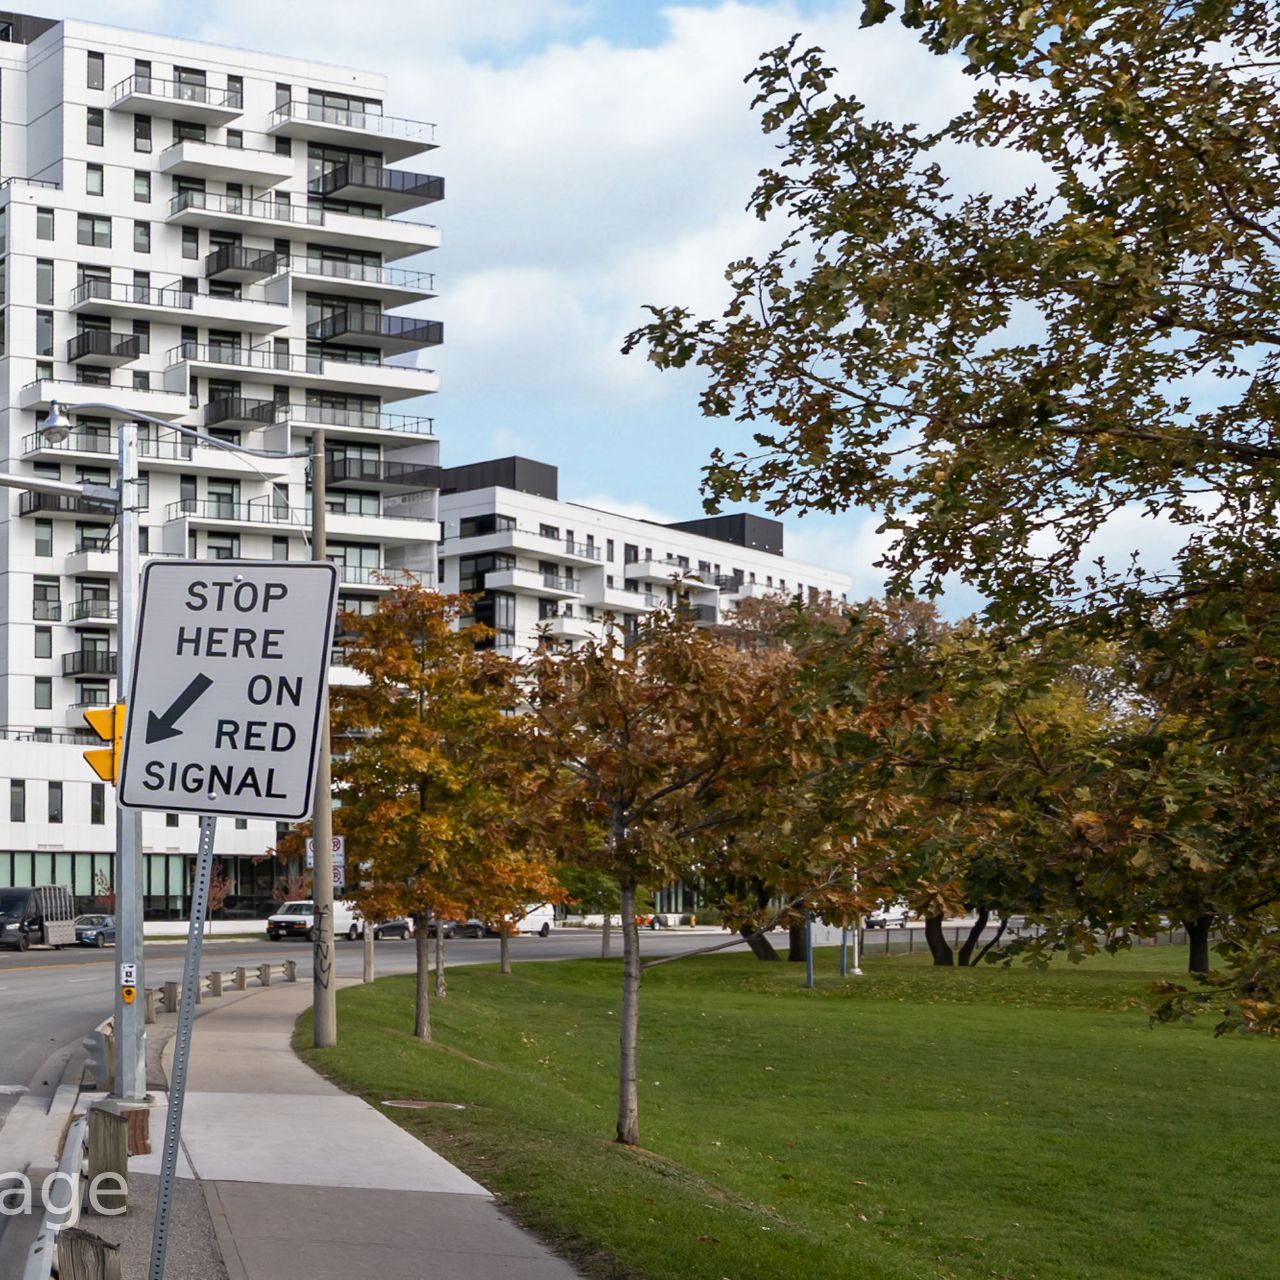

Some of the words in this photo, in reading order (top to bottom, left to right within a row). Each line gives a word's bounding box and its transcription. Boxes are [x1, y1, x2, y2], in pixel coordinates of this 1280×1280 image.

[184, 580, 288, 613] STOP
[176, 626, 285, 660] HERE
[247, 674, 303, 707] ON
[215, 719, 296, 752] RED
[142, 760, 287, 799] SIGNAL
